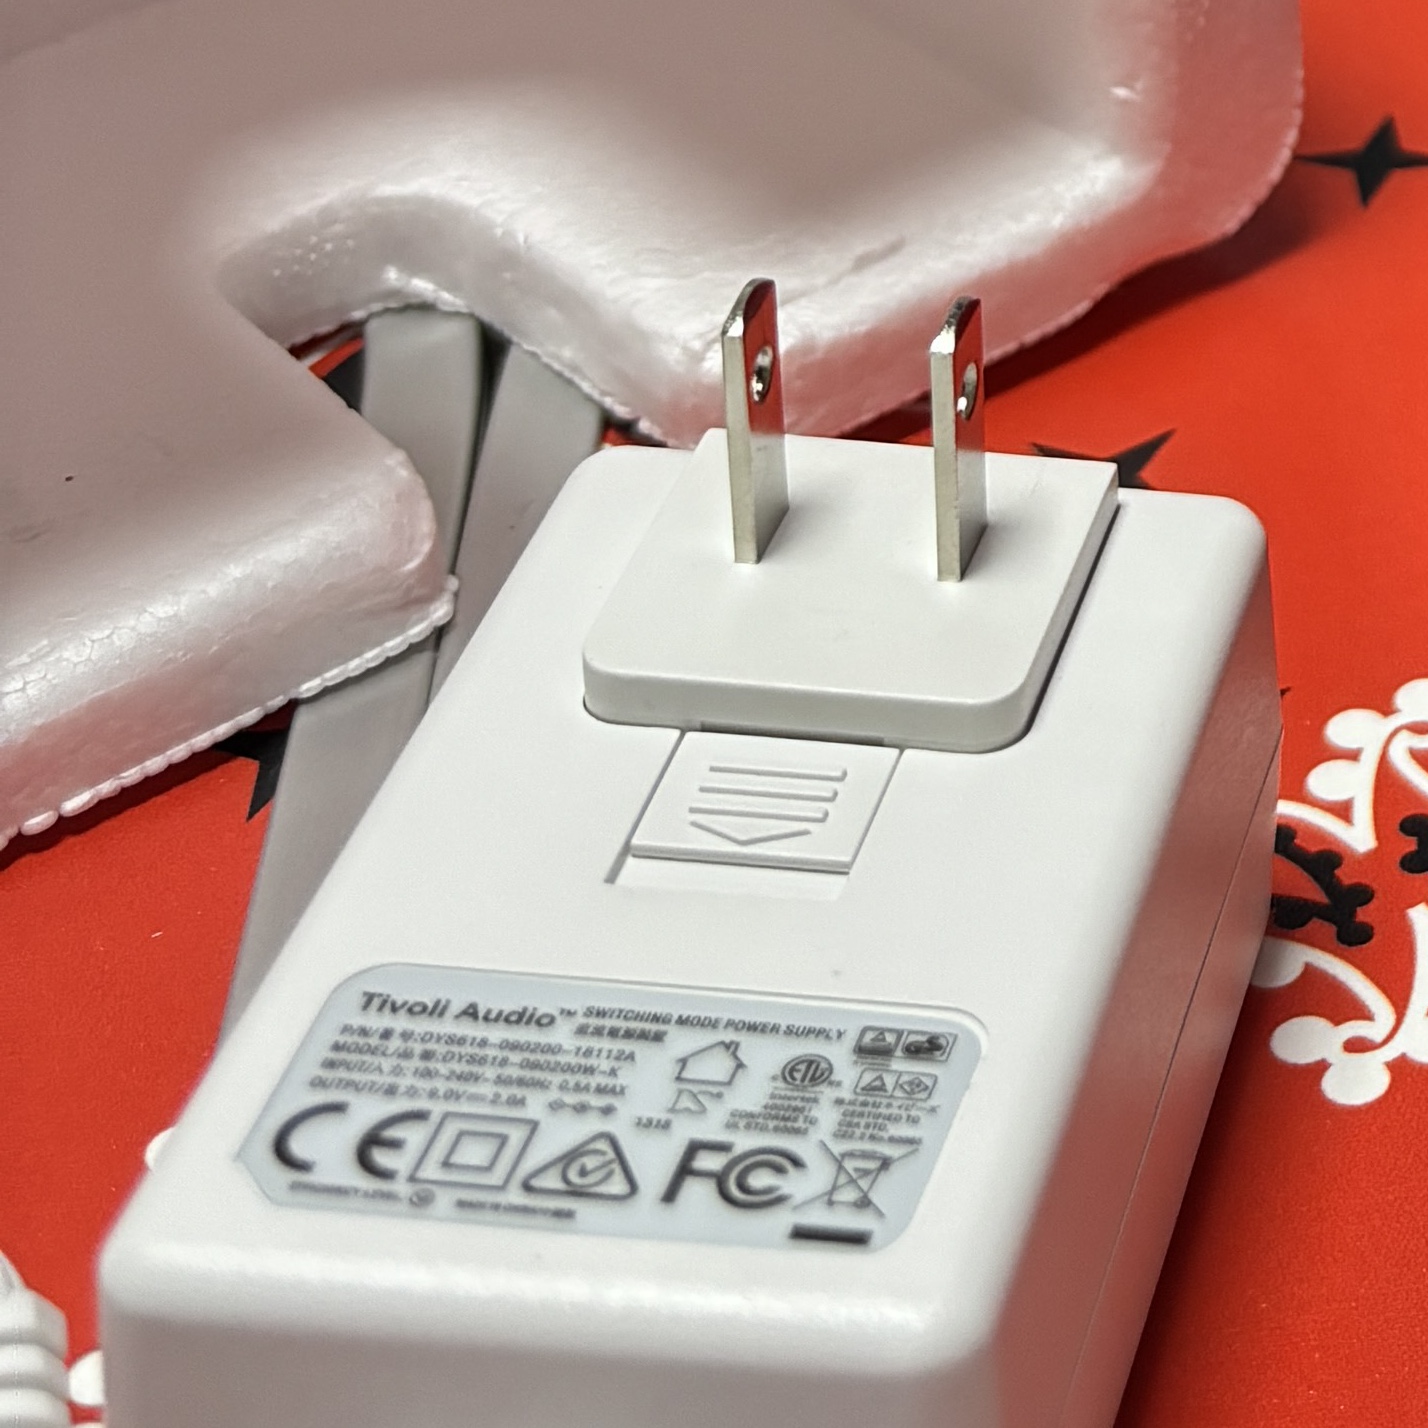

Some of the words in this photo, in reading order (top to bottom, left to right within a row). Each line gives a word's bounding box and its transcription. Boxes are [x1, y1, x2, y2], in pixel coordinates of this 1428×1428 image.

[361, 991, 451, 1019] Tivoli
[583, 1005, 673, 1026] SWITCHING
[675, 1014, 722, 1030] MODE
[723, 1017, 781, 1034] POWER
[782, 1023, 847, 1040] SUPPLY
